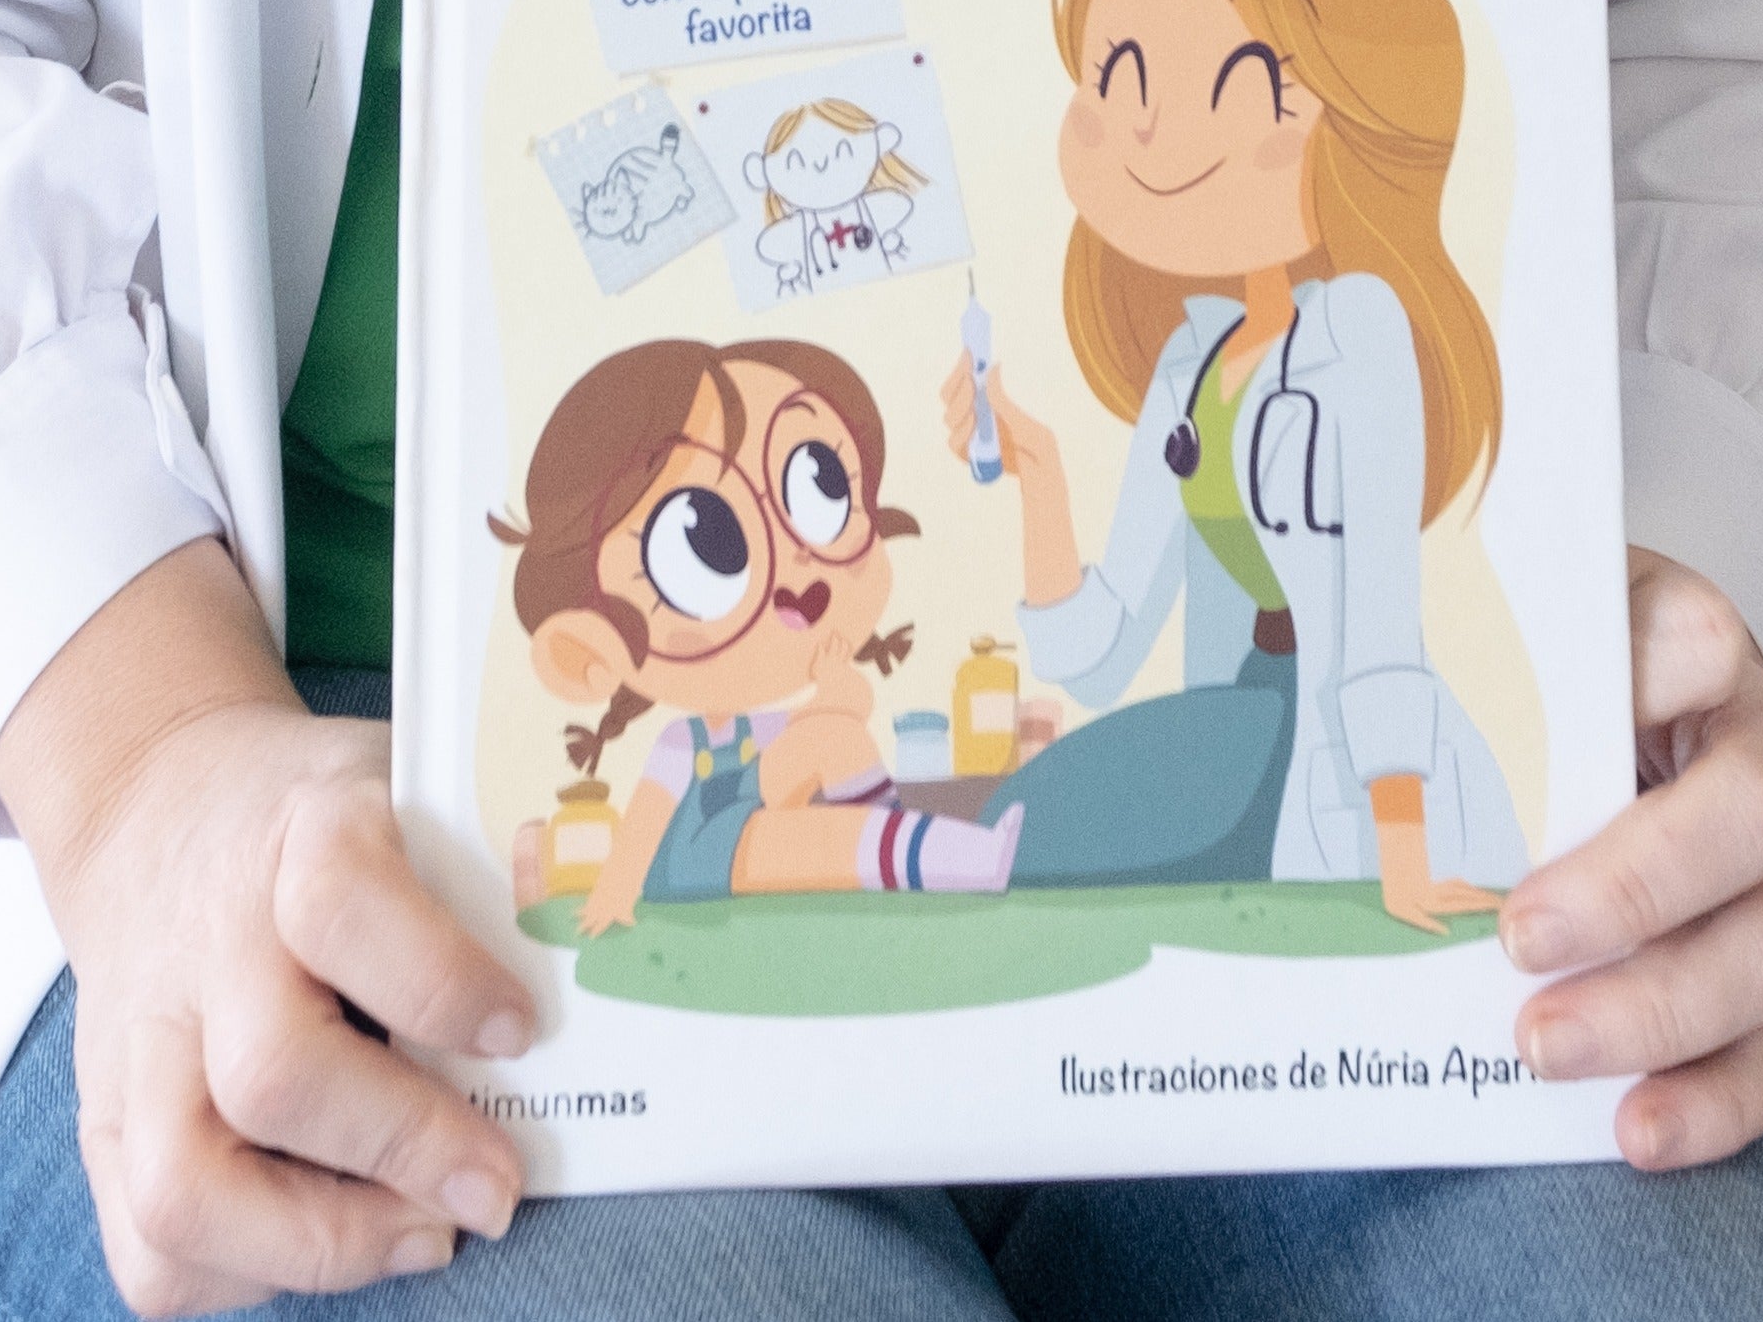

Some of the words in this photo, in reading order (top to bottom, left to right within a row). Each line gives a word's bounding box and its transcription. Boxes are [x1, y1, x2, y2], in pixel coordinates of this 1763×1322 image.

[685, 1, 812, 45] favorita
[1060, 1055, 1278, 1095] Ilustraciones
[1289, 1050, 1327, 1089] de
[1338, 1047, 1430, 1087] Núria
